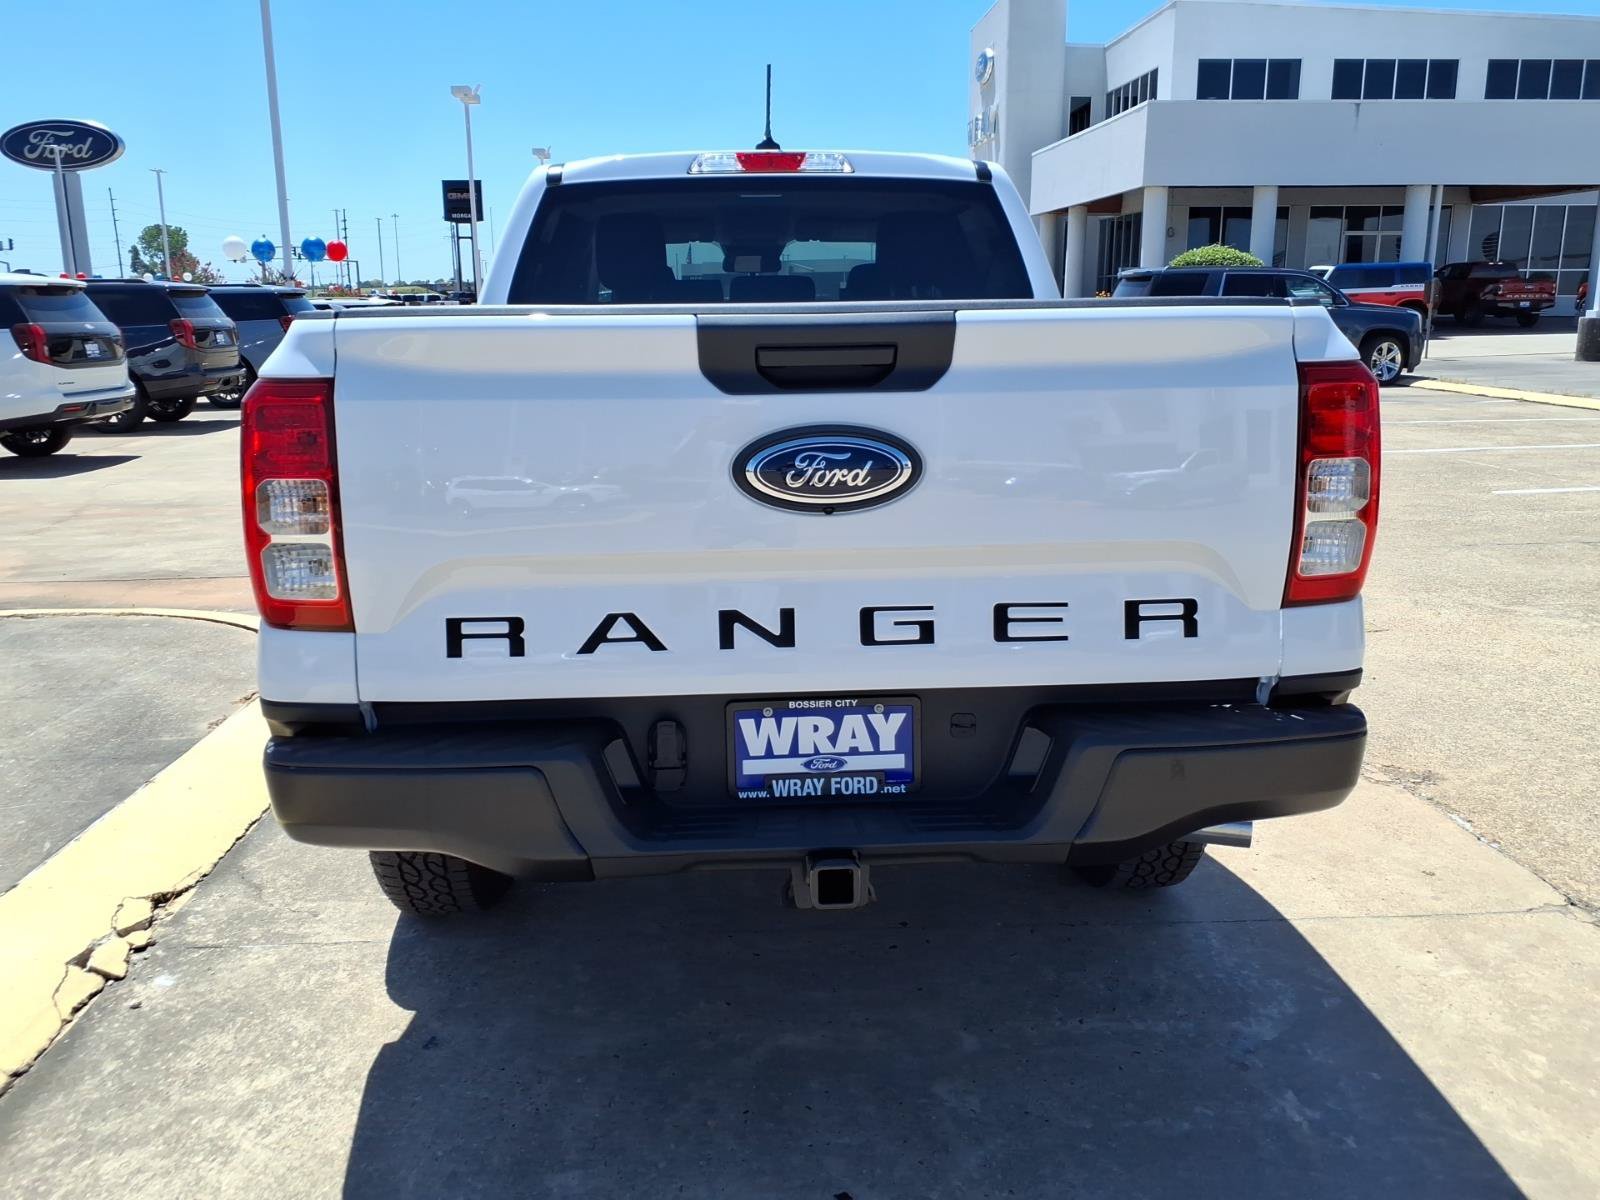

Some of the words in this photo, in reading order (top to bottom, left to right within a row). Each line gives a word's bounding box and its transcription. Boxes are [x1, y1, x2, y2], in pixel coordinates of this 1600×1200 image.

[23, 129, 93, 159] Ford
[785, 451, 873, 488] Ford
[445, 597, 1199, 659] RANGER
[788, 700, 833, 709] BOSSIER
[834, 699, 858, 708] CITY
[738, 712, 907, 757] WRAY
[810, 758, 838, 770] Ford
[738, 790, 770, 799] www.
[772, 778, 825, 798] WRAY
[830, 776, 878, 796] FORD
[880, 783, 907, 794] .net
